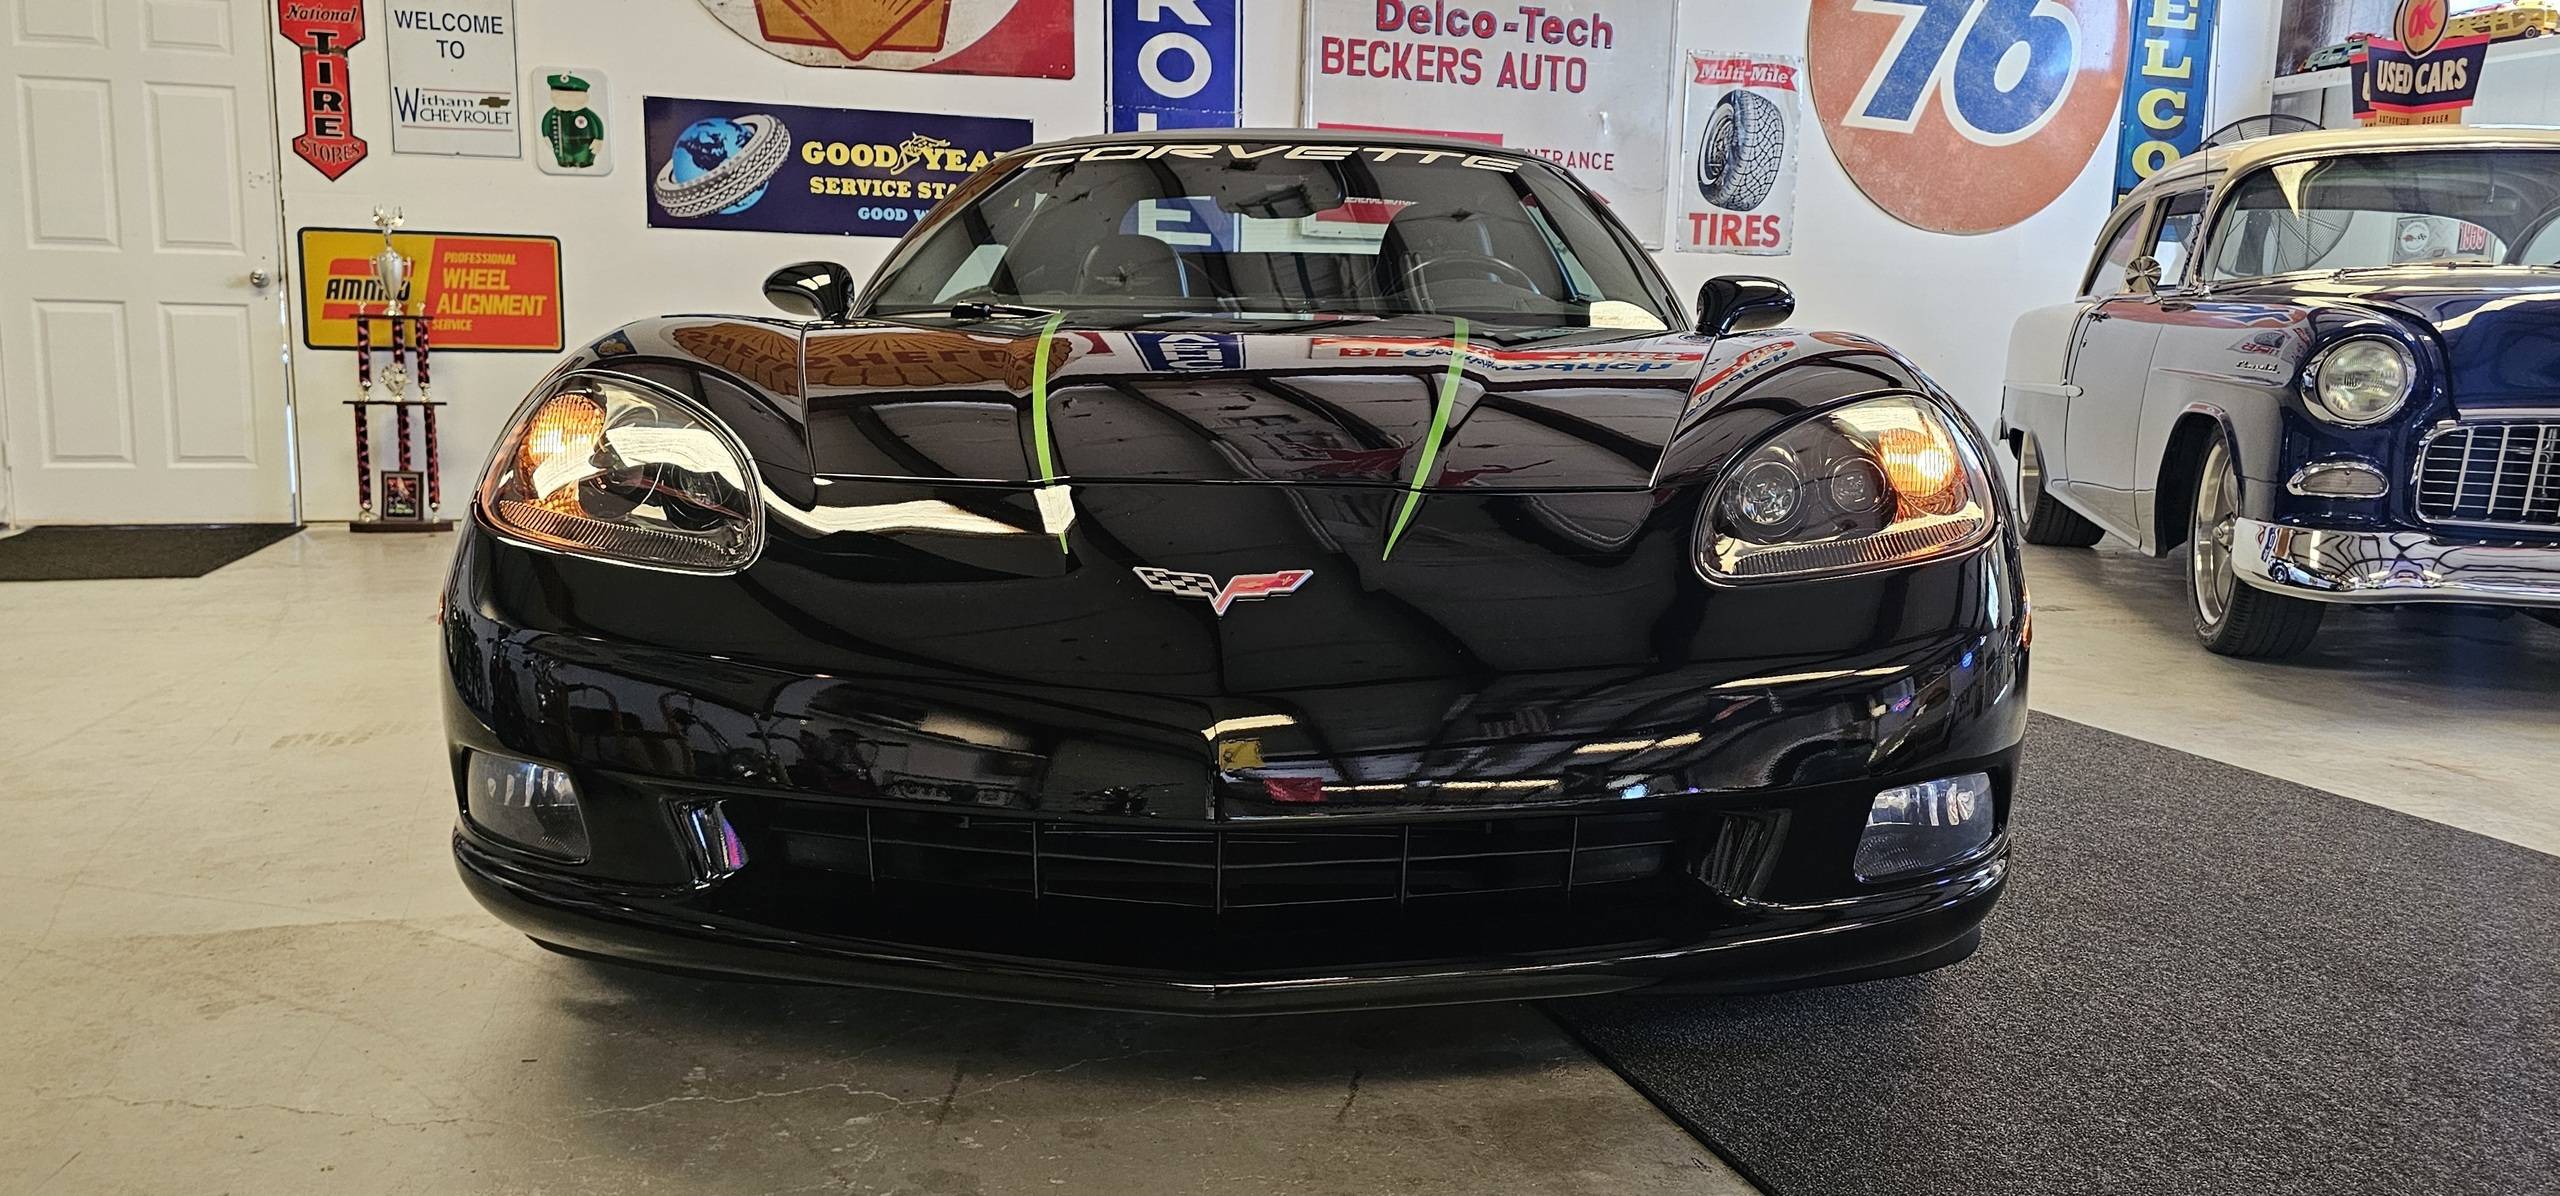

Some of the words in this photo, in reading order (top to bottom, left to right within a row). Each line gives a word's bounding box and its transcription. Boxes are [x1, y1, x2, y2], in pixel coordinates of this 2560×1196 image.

[286, 5, 357, 23] National
[394, 10, 504, 34] WELCOME
[2408, 0, 2437, 38] OK
[436, 39, 465, 59] TO
[1321, 36, 1483, 86] BECKERS
[1496, 52, 1587, 93] AUTO
[1699, 63, 1789, 83] Multi-Mile
[1841, 0, 2082, 147] 76
[2377, 59, 2413, 94] USED
[2415, 57, 2468, 94] CARS
[306, 29, 344, 140] TIRE
[394, 86, 474, 122] Witham
[420, 108, 512, 125] CHEVROLET
[299, 138, 361, 164] STORES
[1022, 144, 1524, 174] CORVETTE
[809, 176, 912, 198] SERVICE
[858, 207, 908, 222] GOOD
[1689, 213, 1781, 248] TIRES
[443, 251, 517, 265] PROFESSIONAL
[442, 268, 511, 290] WHEEL
[436, 293, 548, 317] ALIGNMENT
[431, 318, 473, 332] SERVICE
